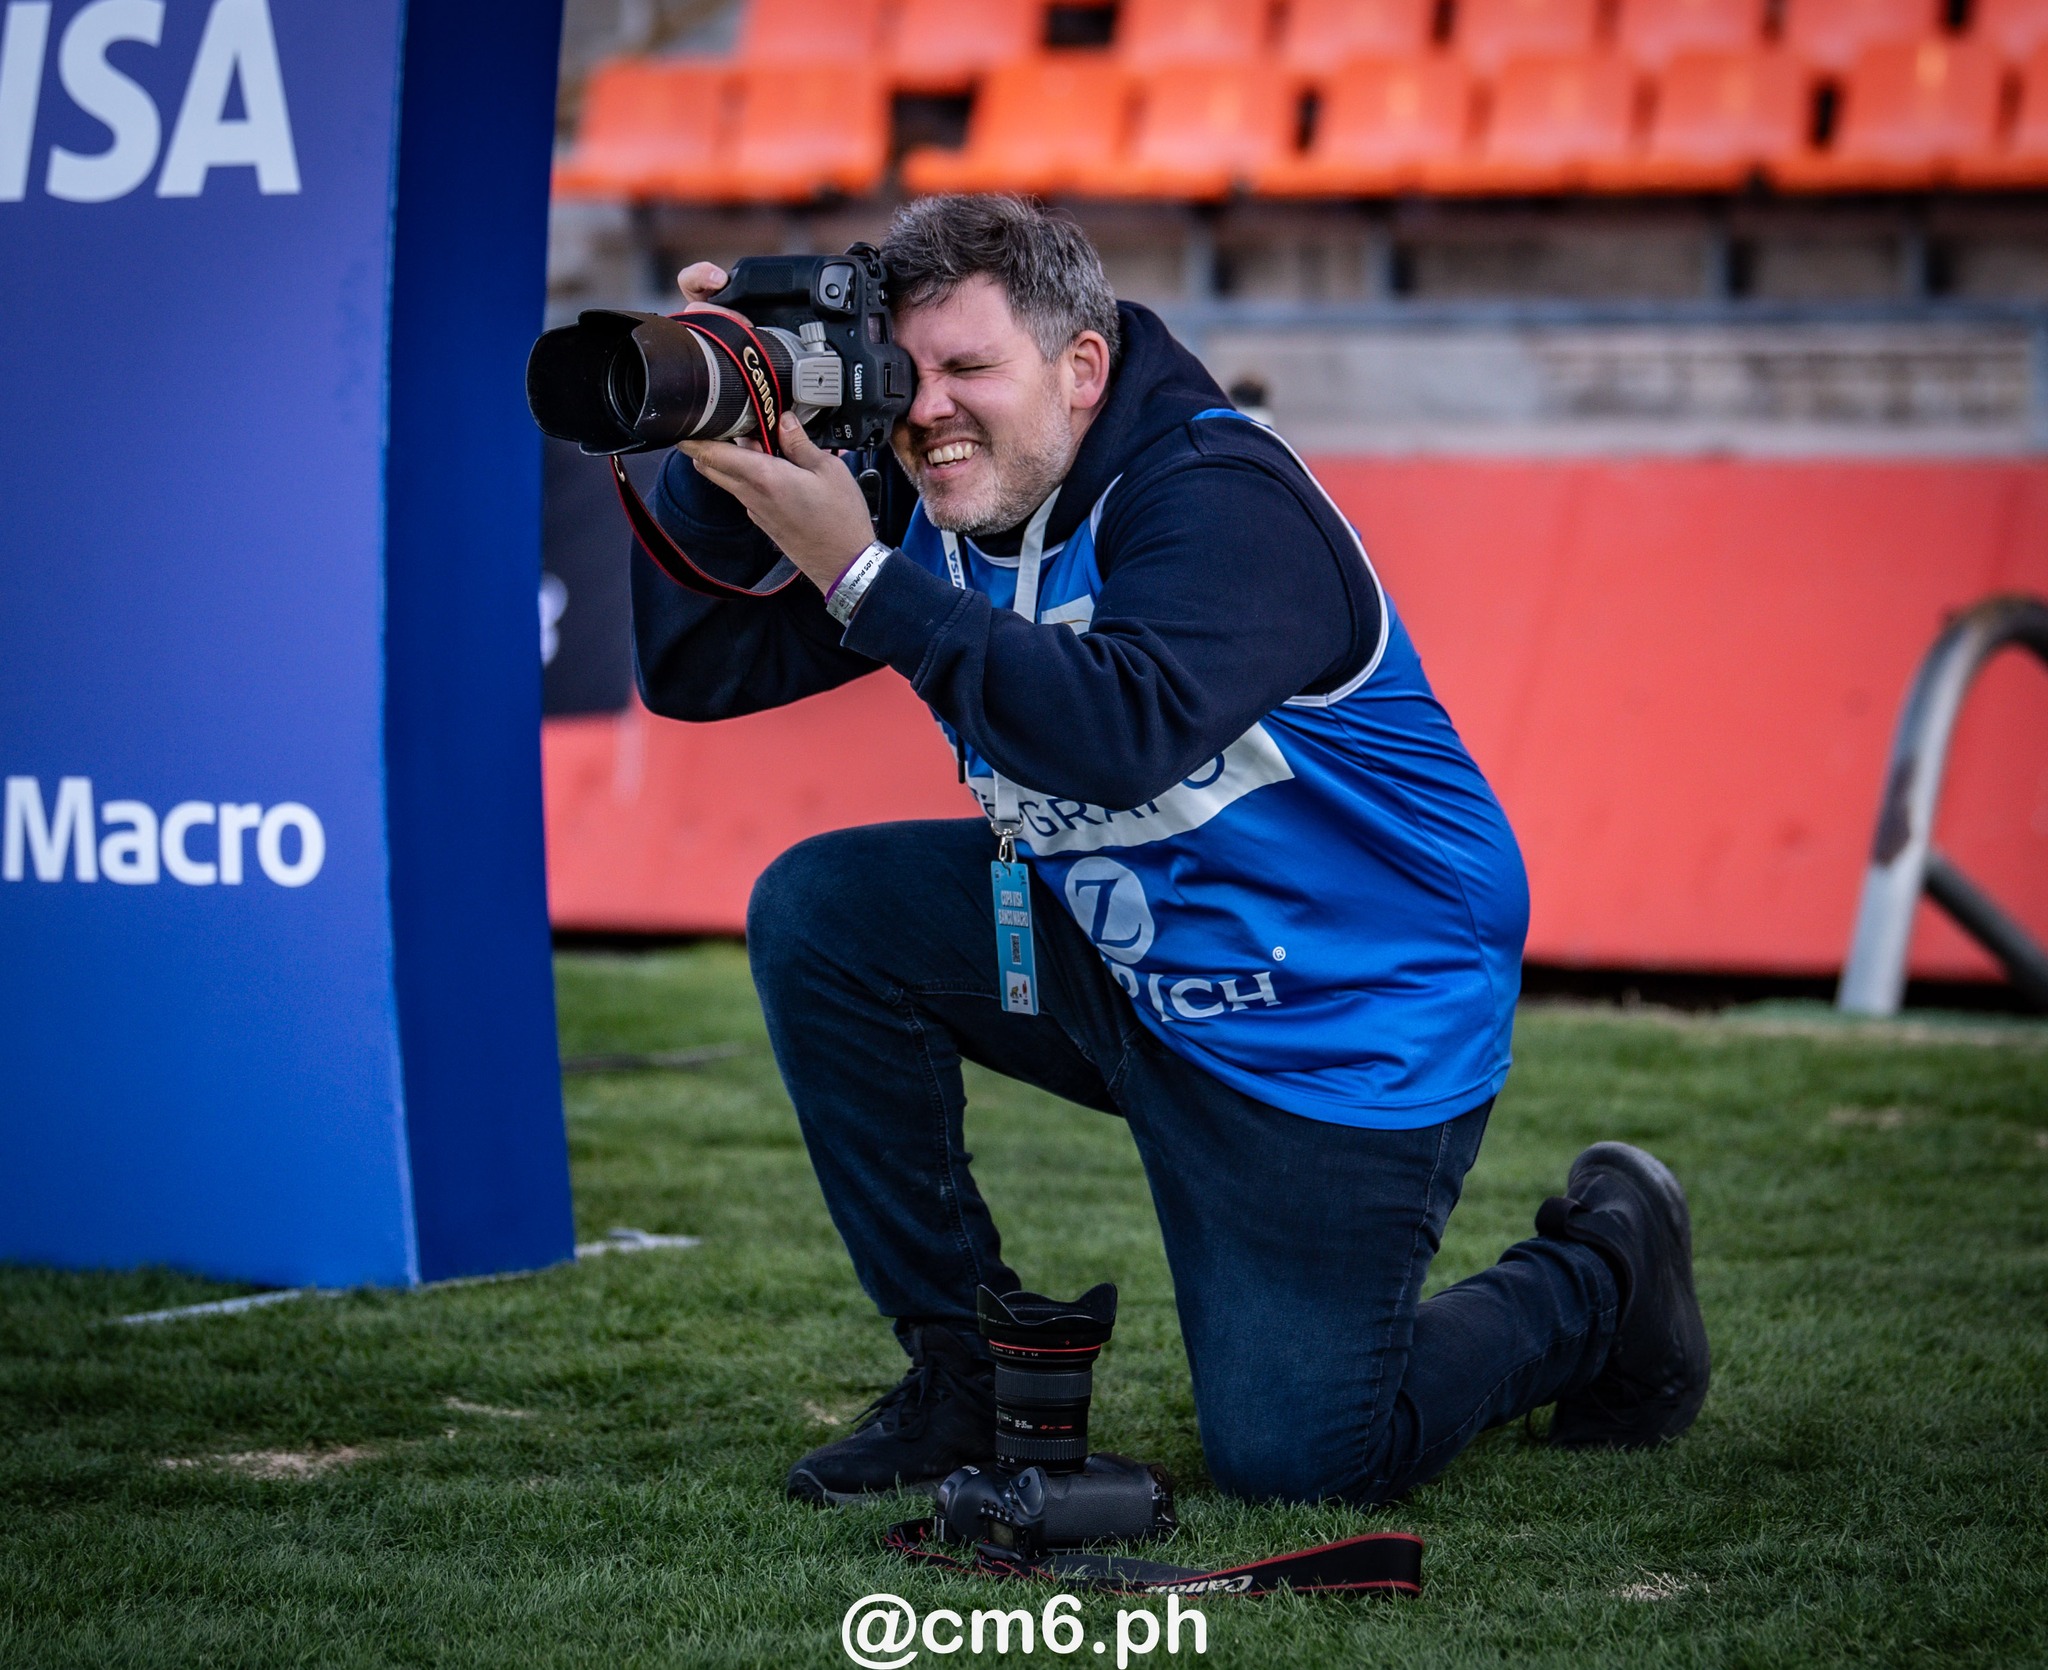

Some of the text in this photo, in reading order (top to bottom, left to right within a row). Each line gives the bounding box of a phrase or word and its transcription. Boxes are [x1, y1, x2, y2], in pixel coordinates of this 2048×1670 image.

[743, 346, 776, 431] Canon
[854, 363, 864, 401] Canon
[3, 774, 327, 889] Macro
